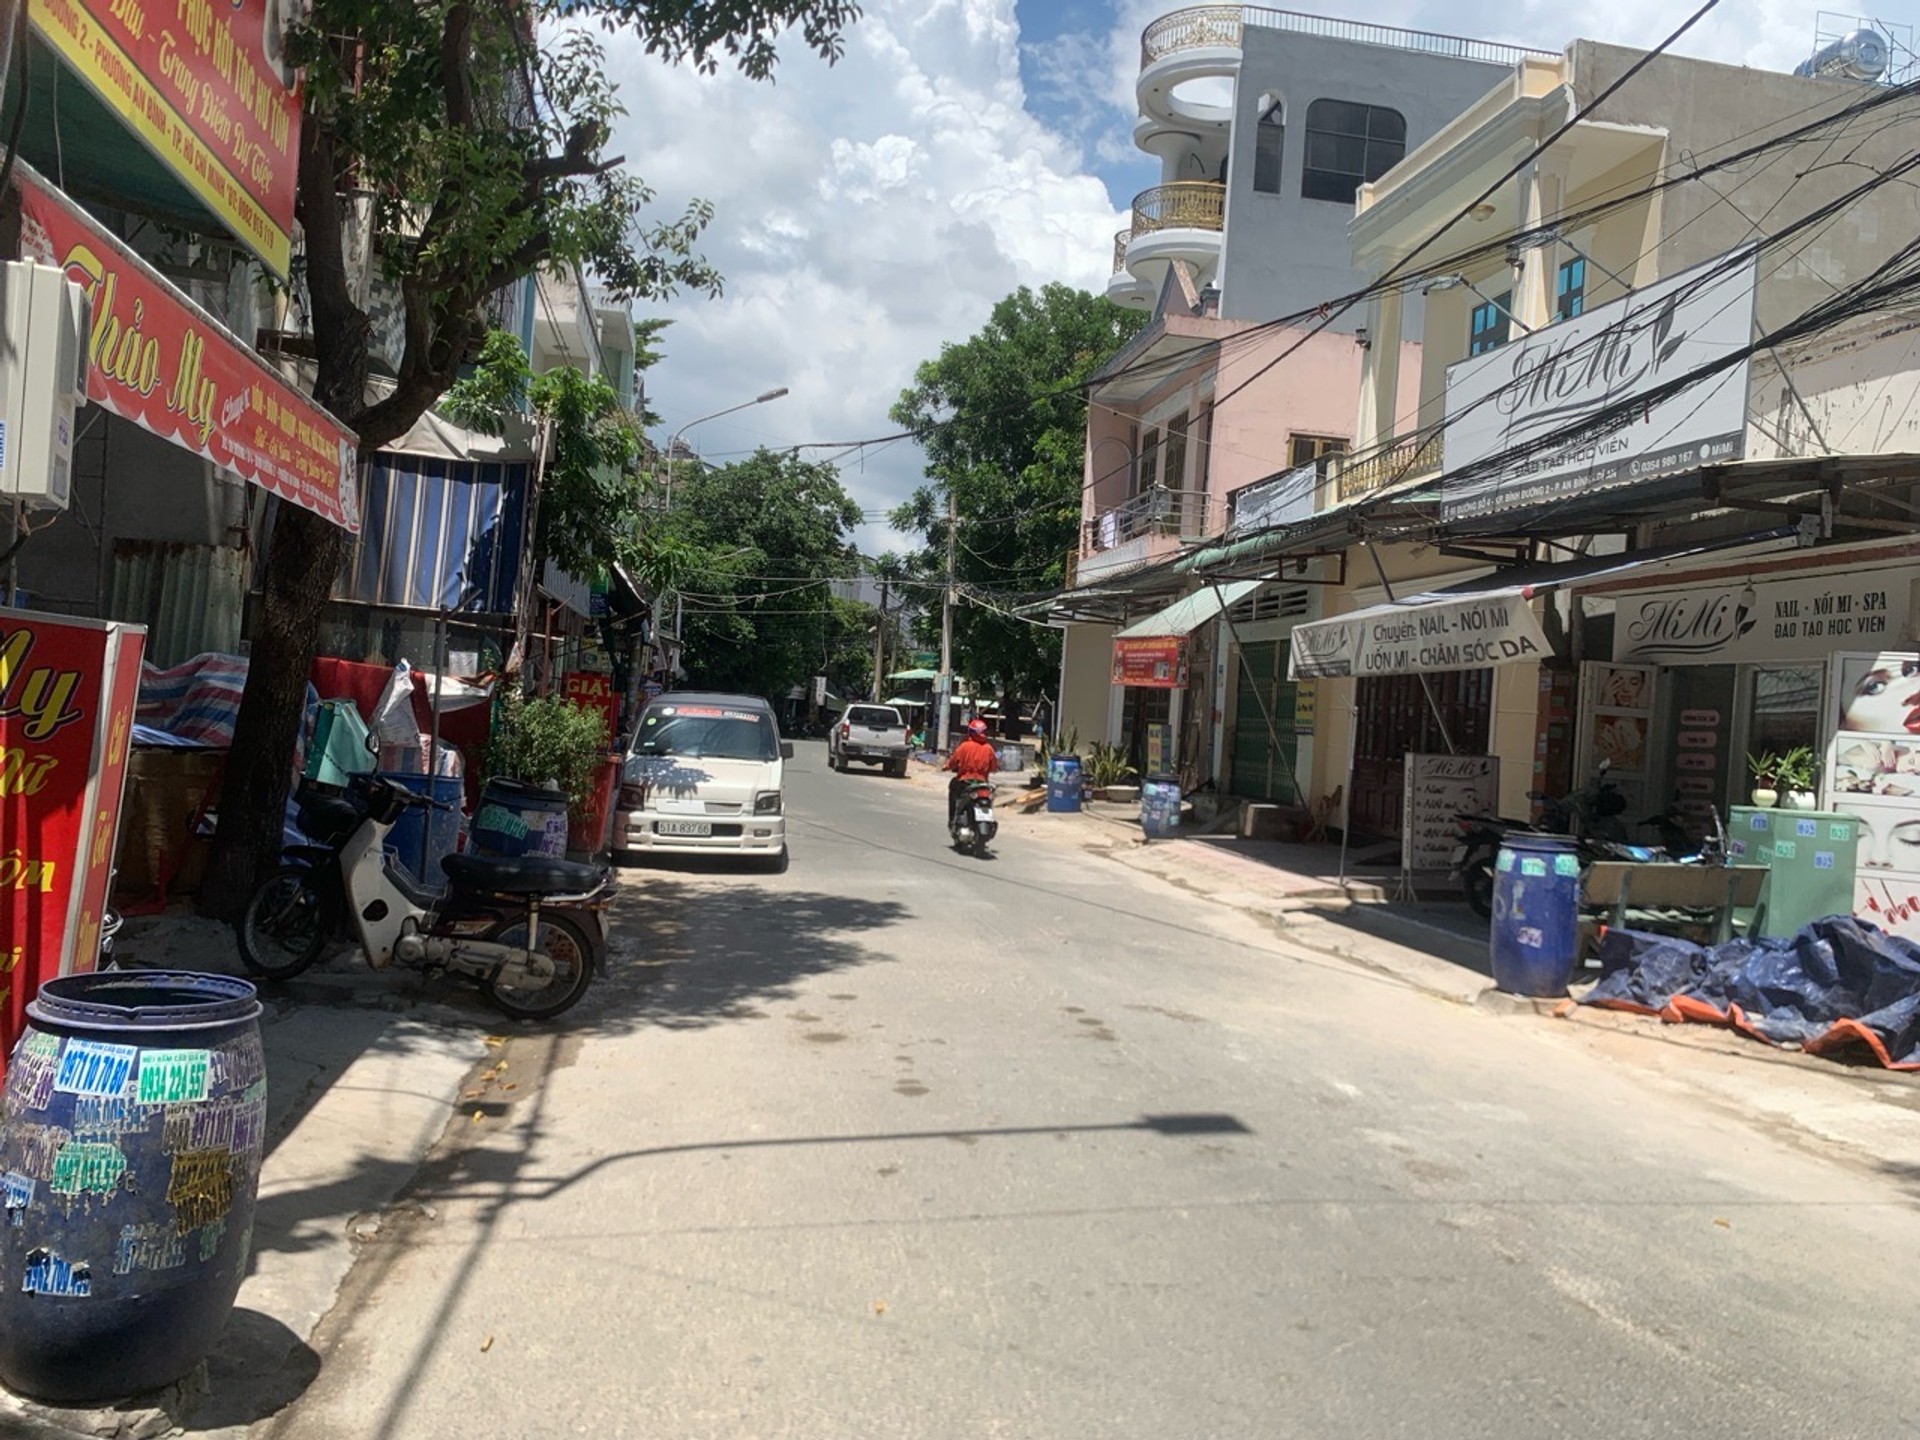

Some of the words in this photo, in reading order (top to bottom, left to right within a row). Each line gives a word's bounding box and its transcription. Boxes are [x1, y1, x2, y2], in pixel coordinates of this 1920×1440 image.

[166, 328, 216, 446] My
[1597, 436, 1629, 456] VIÊN
[1419, 616, 1449, 636] NAIL
[1460, 603, 1487, 632] NỐI
[1490, 607, 1509, 627] MI
[1628, 594, 1731, 641] MiMi
[1775, 600, 1800, 618] NAIL
[1813, 591, 1833, 616] NỐI
[1836, 595, 1852, 613] MI
[1863, 591, 1887, 611] SPA
[1366, 645, 1392, 670] UỐN
[1395, 650, 1409, 668] MI
[1419, 643, 1460, 666] CHĂM
[1463, 637, 1500, 663] SÓC
[1499, 635, 1538, 657] DA
